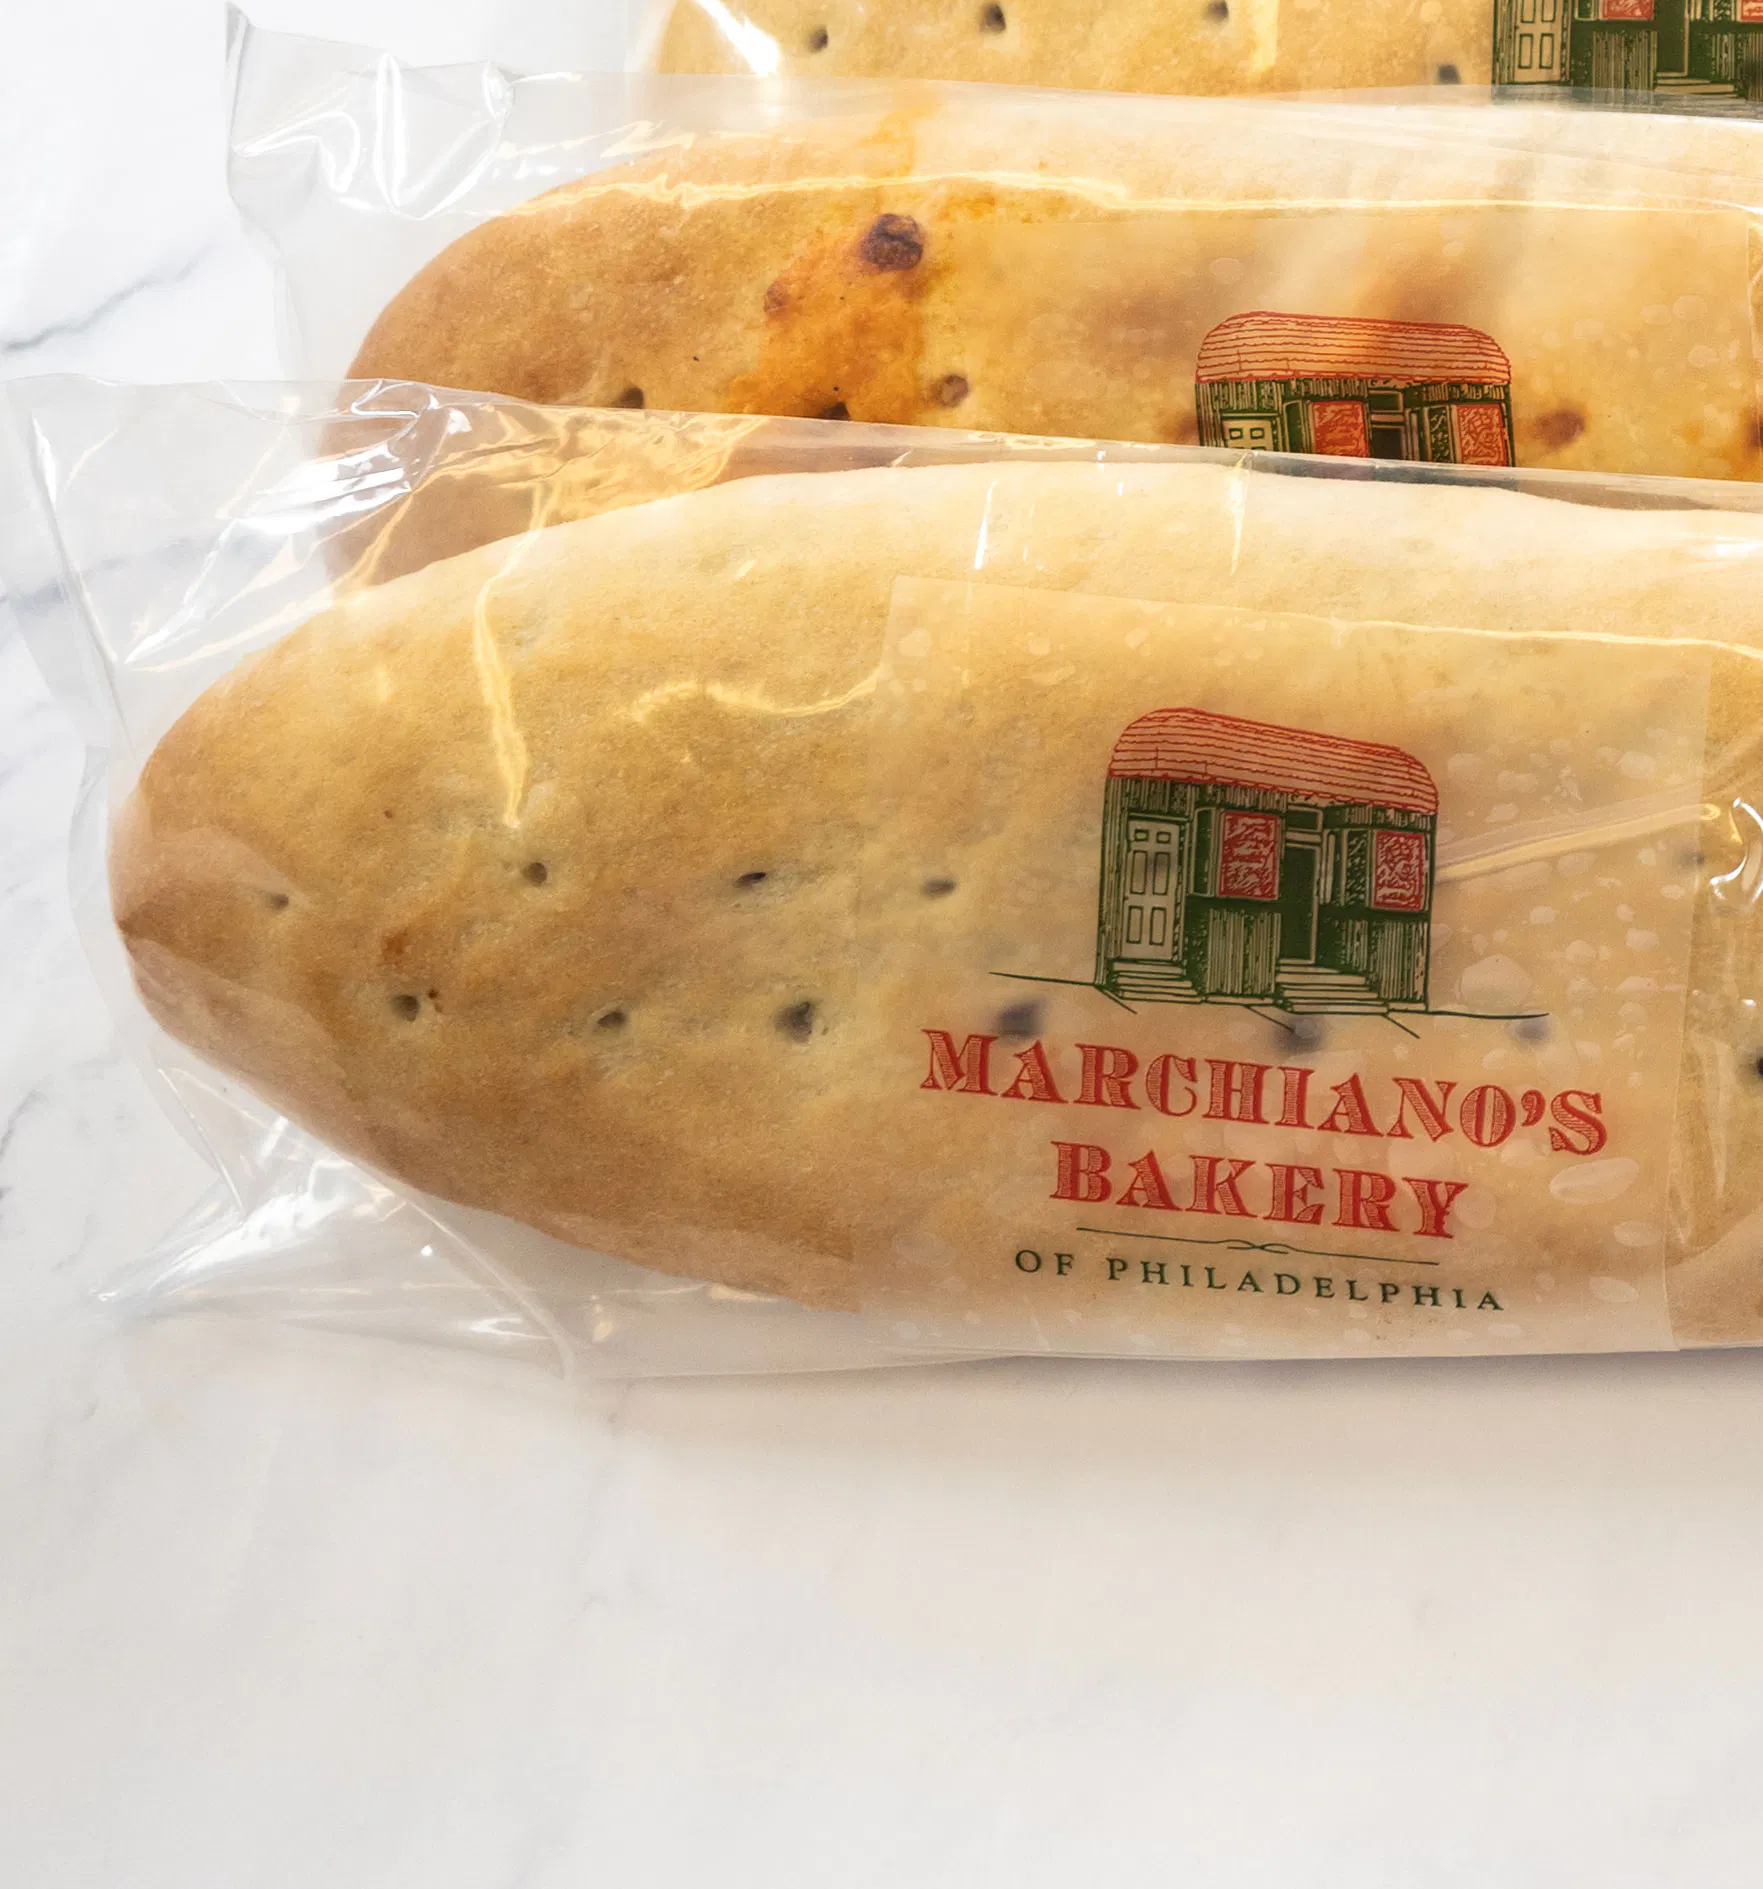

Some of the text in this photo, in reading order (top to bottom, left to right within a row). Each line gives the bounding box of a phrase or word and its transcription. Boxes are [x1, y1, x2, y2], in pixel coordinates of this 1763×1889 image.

[919, 1027, 1609, 1157] MARCHIANO'S
[1048, 1140, 1470, 1240] BAKERY
[1014, 1249, 1505, 1312] OF PHILADELPHIA
